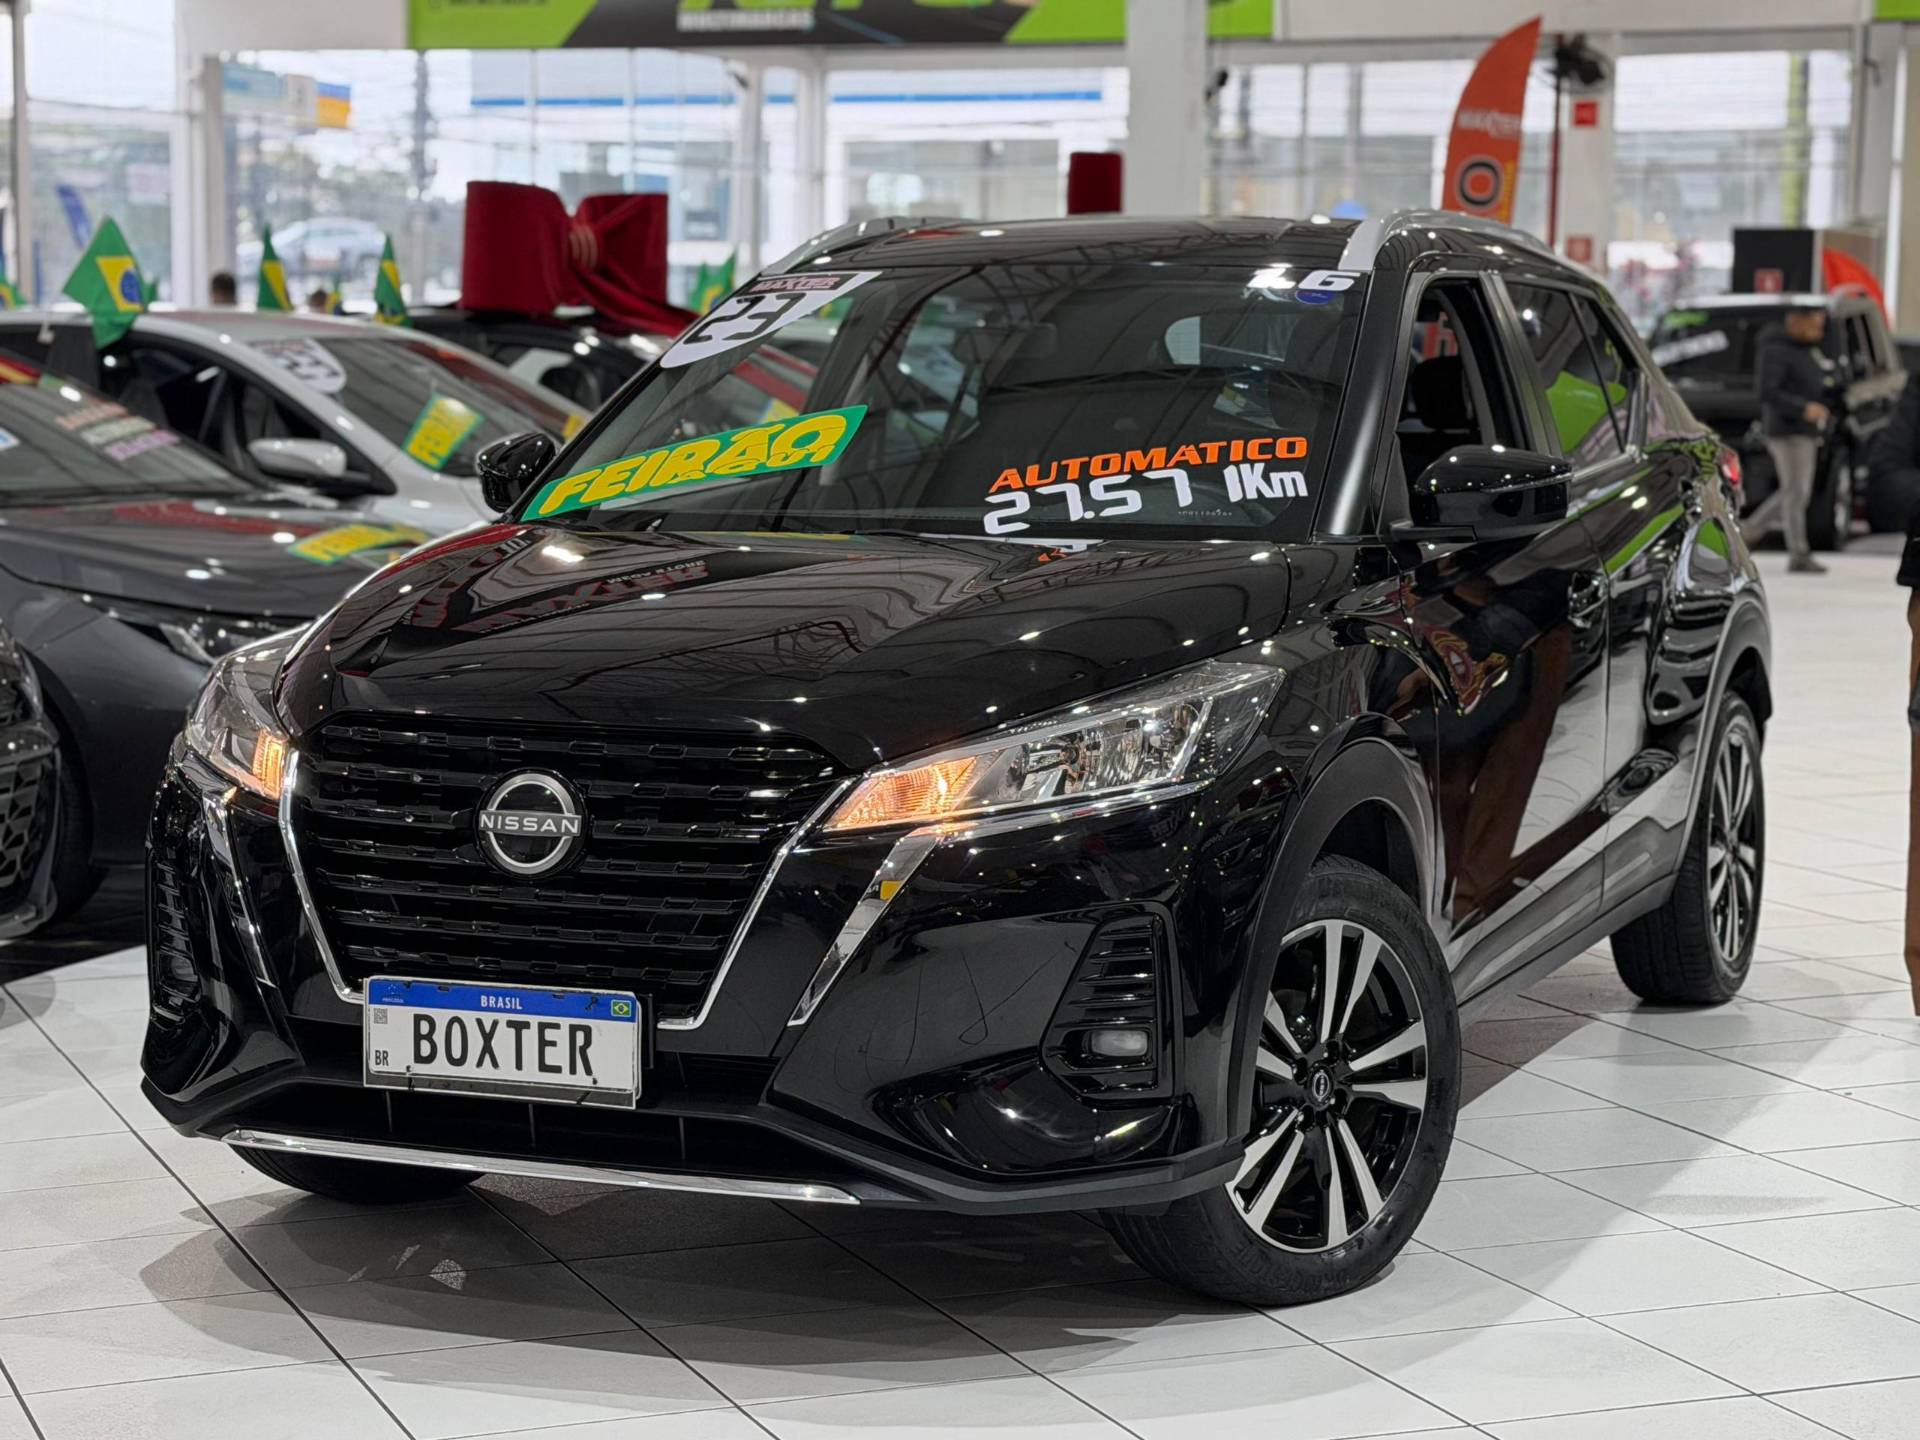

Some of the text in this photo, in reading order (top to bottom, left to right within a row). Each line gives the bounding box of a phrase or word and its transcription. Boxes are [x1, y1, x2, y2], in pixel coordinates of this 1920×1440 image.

[683, 293, 807, 344] 23
[537, 414, 847, 516] FEIRÃO
[480, 814, 578, 833] NISSAN
[480, 995, 522, 1010] BRASIL
[374, 1050, 389, 1067] BR
[413, 1013, 593, 1077] BOXTER
